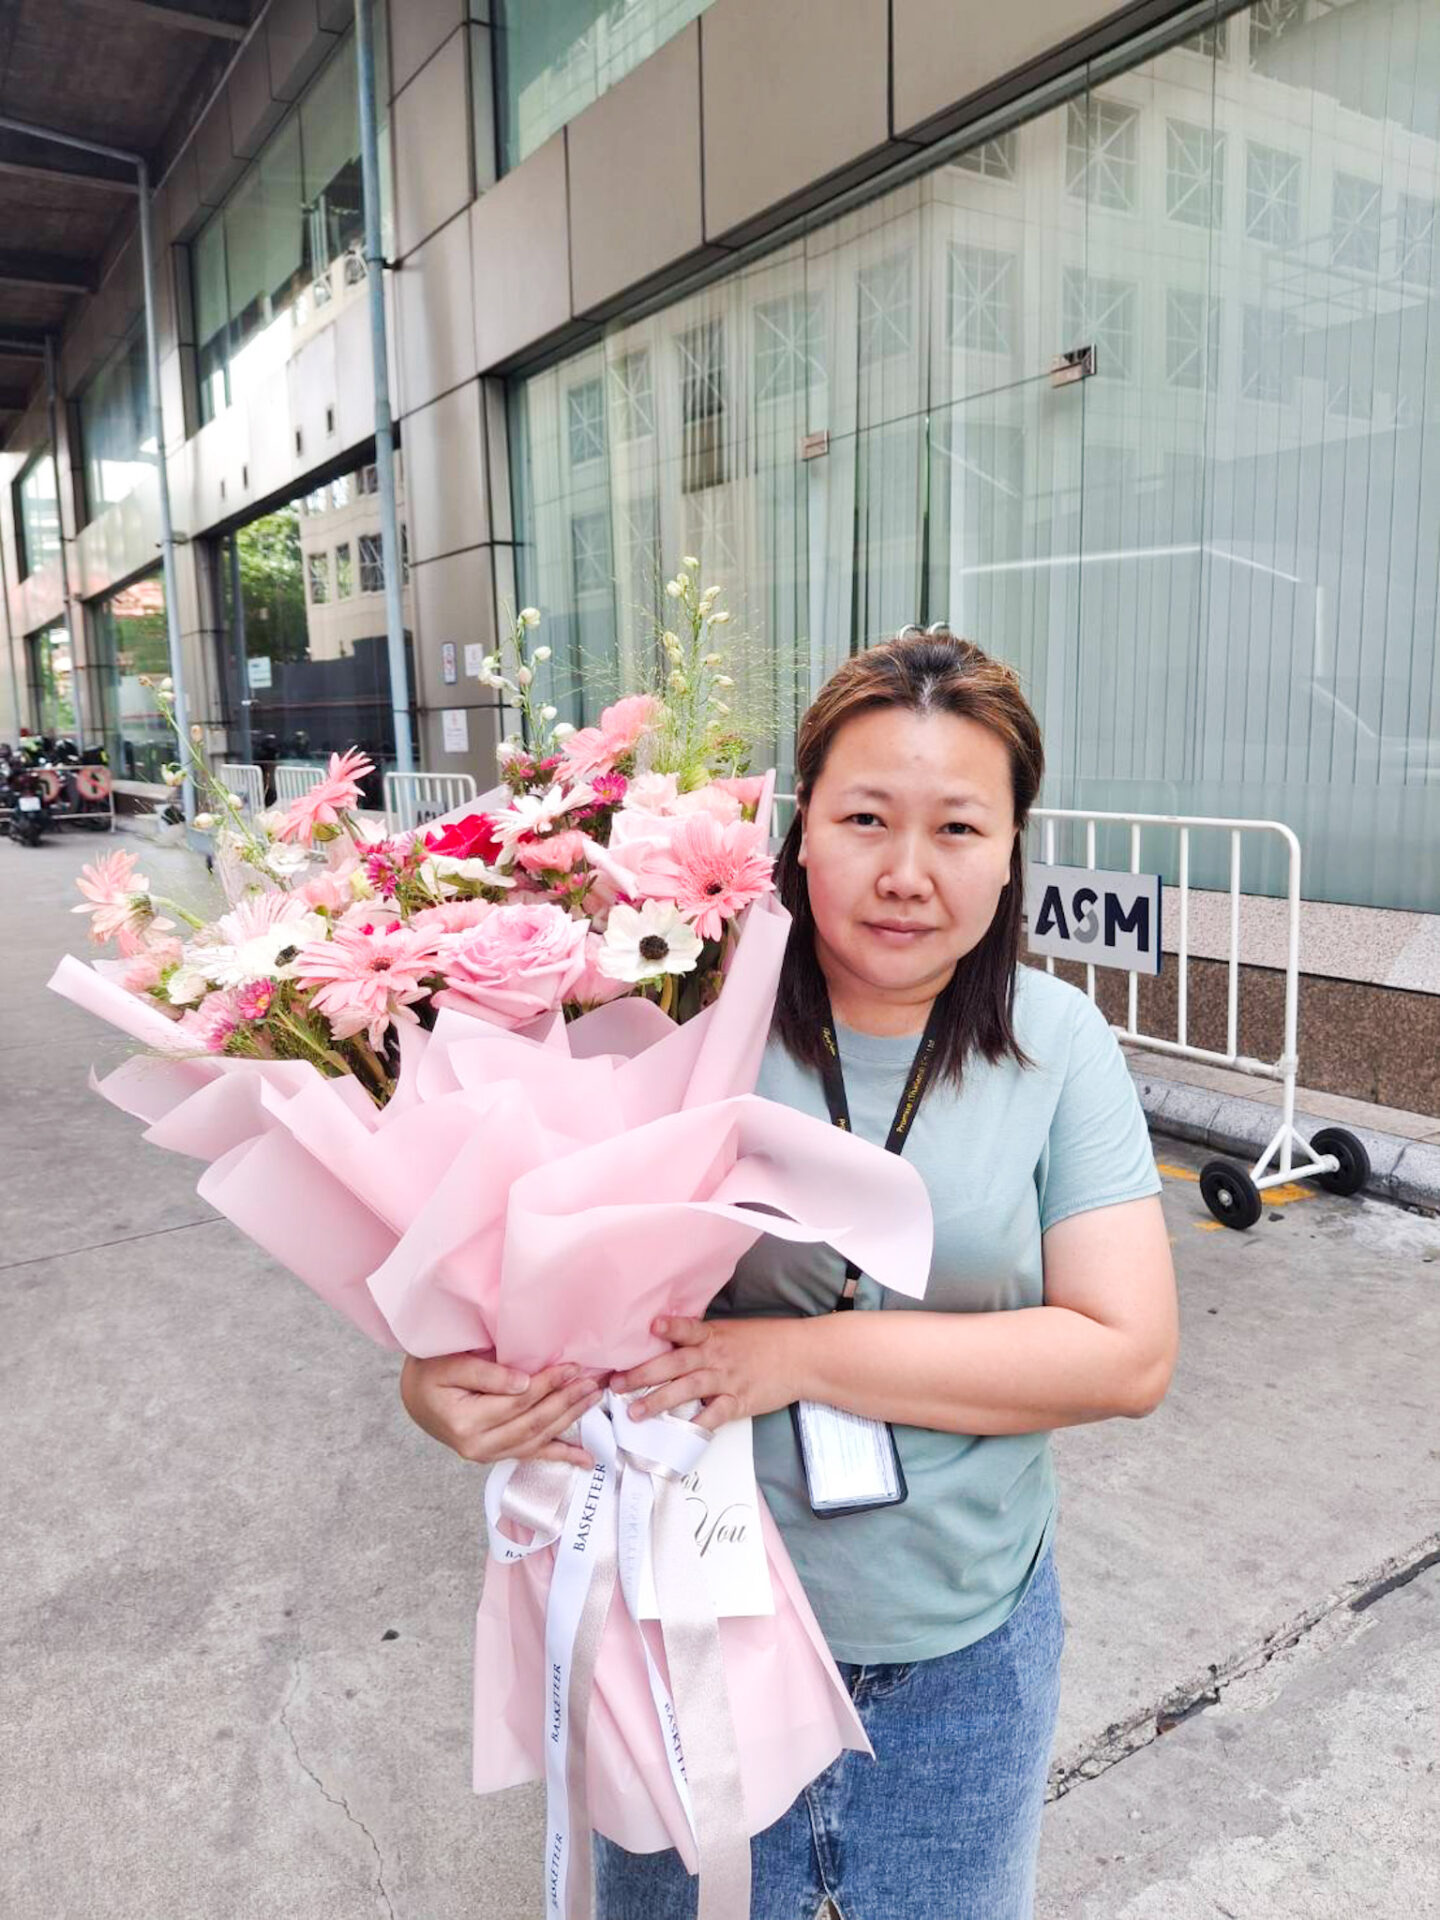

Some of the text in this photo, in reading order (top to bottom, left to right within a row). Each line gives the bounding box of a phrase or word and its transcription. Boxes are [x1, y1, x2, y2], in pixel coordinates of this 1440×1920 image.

[1034, 885, 1150, 953] ASM
[573, 1463, 607, 1552] BASKETEER
[685, 1497, 752, 1558] You
[551, 1664, 562, 1743] BASKETEER
[550, 1833, 563, 1909] BASKETEER
